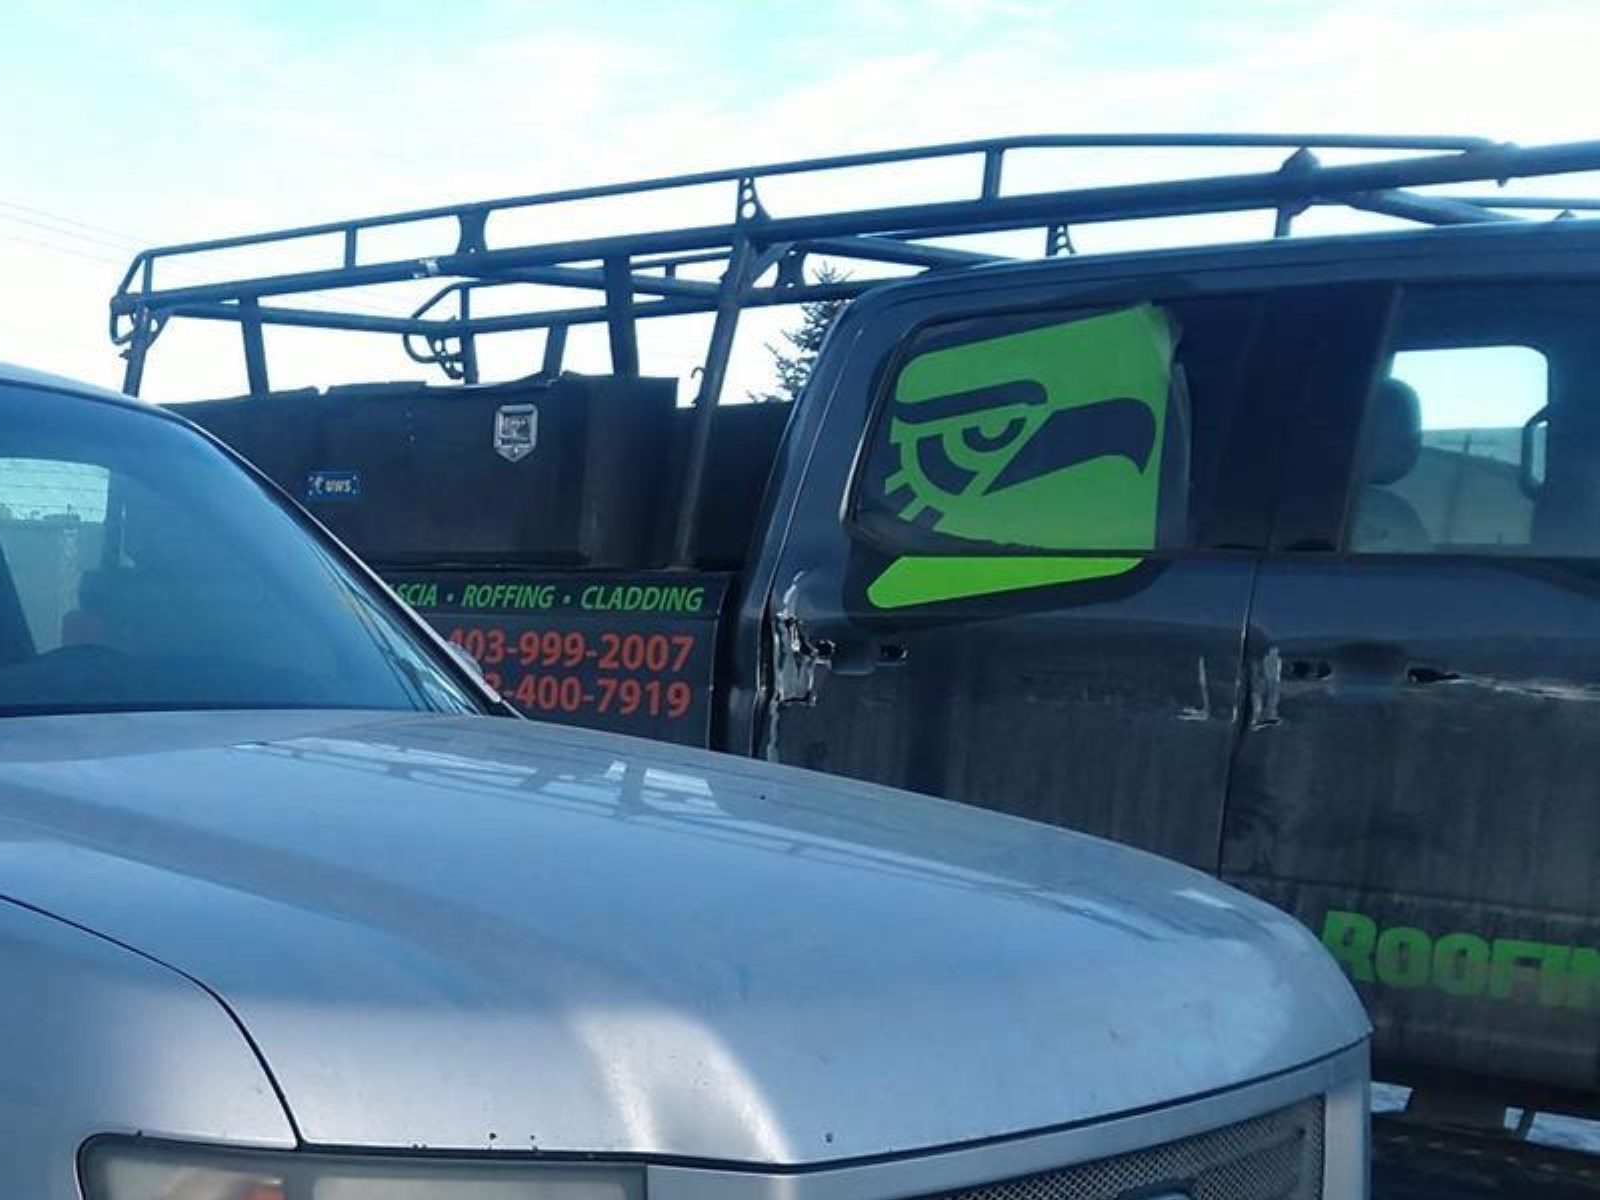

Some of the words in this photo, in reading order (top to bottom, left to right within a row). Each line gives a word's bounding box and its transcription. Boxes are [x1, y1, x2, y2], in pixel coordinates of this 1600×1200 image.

[388, 583, 438, 607] SCIA
[460, 584, 557, 609] ROFFING
[580, 585, 705, 611] CLADDING
